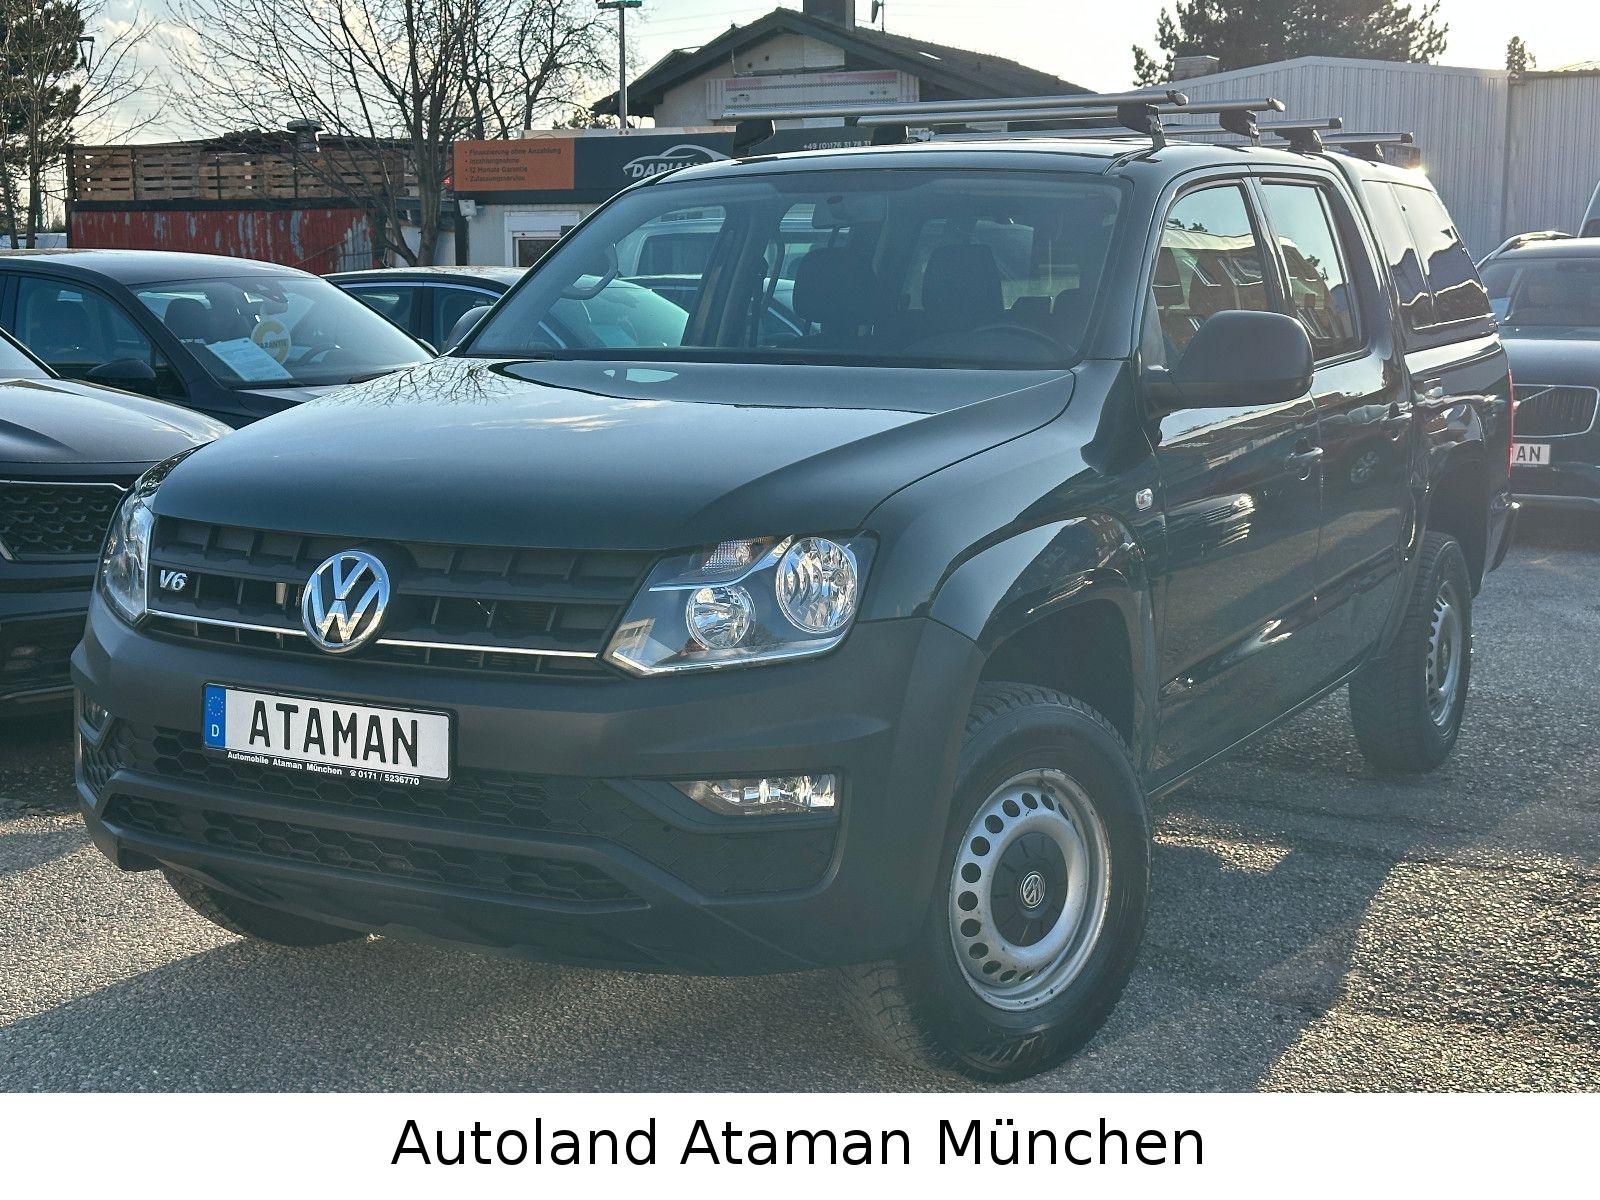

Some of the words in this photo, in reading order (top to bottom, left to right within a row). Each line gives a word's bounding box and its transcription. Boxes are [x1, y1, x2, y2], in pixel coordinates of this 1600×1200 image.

[803, 142, 817, 150] +49
[159, 569, 188, 592] V6
[211, 723, 220, 737] D
[248, 699, 418, 768] ATAMAN
[227, 751, 269, 765] Automobile
[272, 757, 303, 770] Ataman
[306, 762, 343, 776] München
[358, 770, 378, 780] 0171
[384, 774, 420, 786] 5236770
